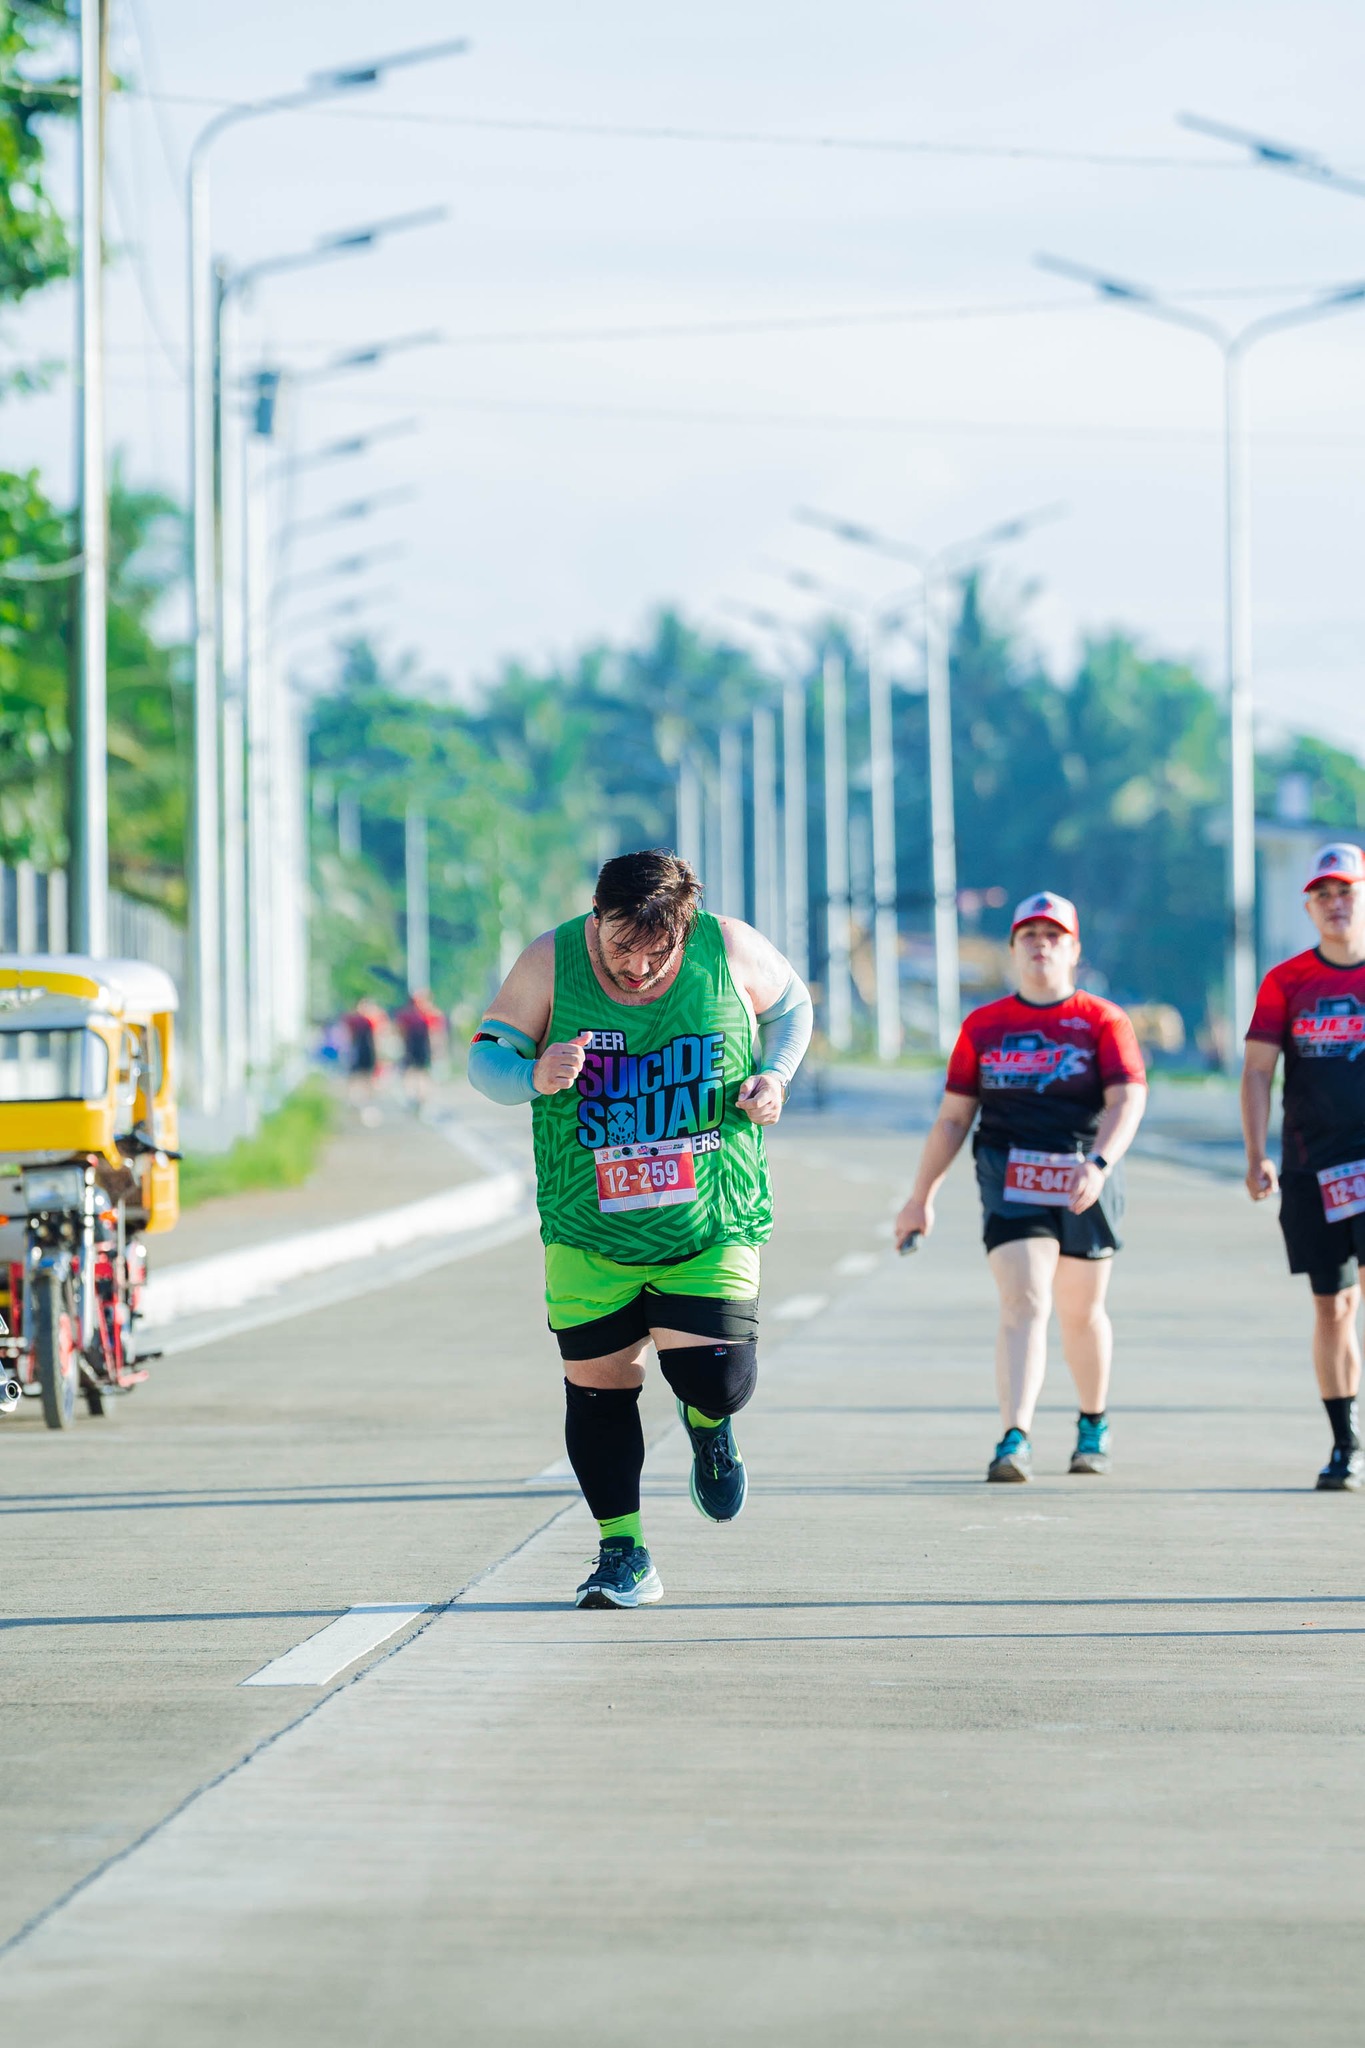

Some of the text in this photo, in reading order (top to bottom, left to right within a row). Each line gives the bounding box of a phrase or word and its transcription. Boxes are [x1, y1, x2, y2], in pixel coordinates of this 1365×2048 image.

[578, 1033, 725, 1099] SUICIDE
[691, 1130, 720, 1155] ERS
[605, 1159, 679, 1193] 12-259
